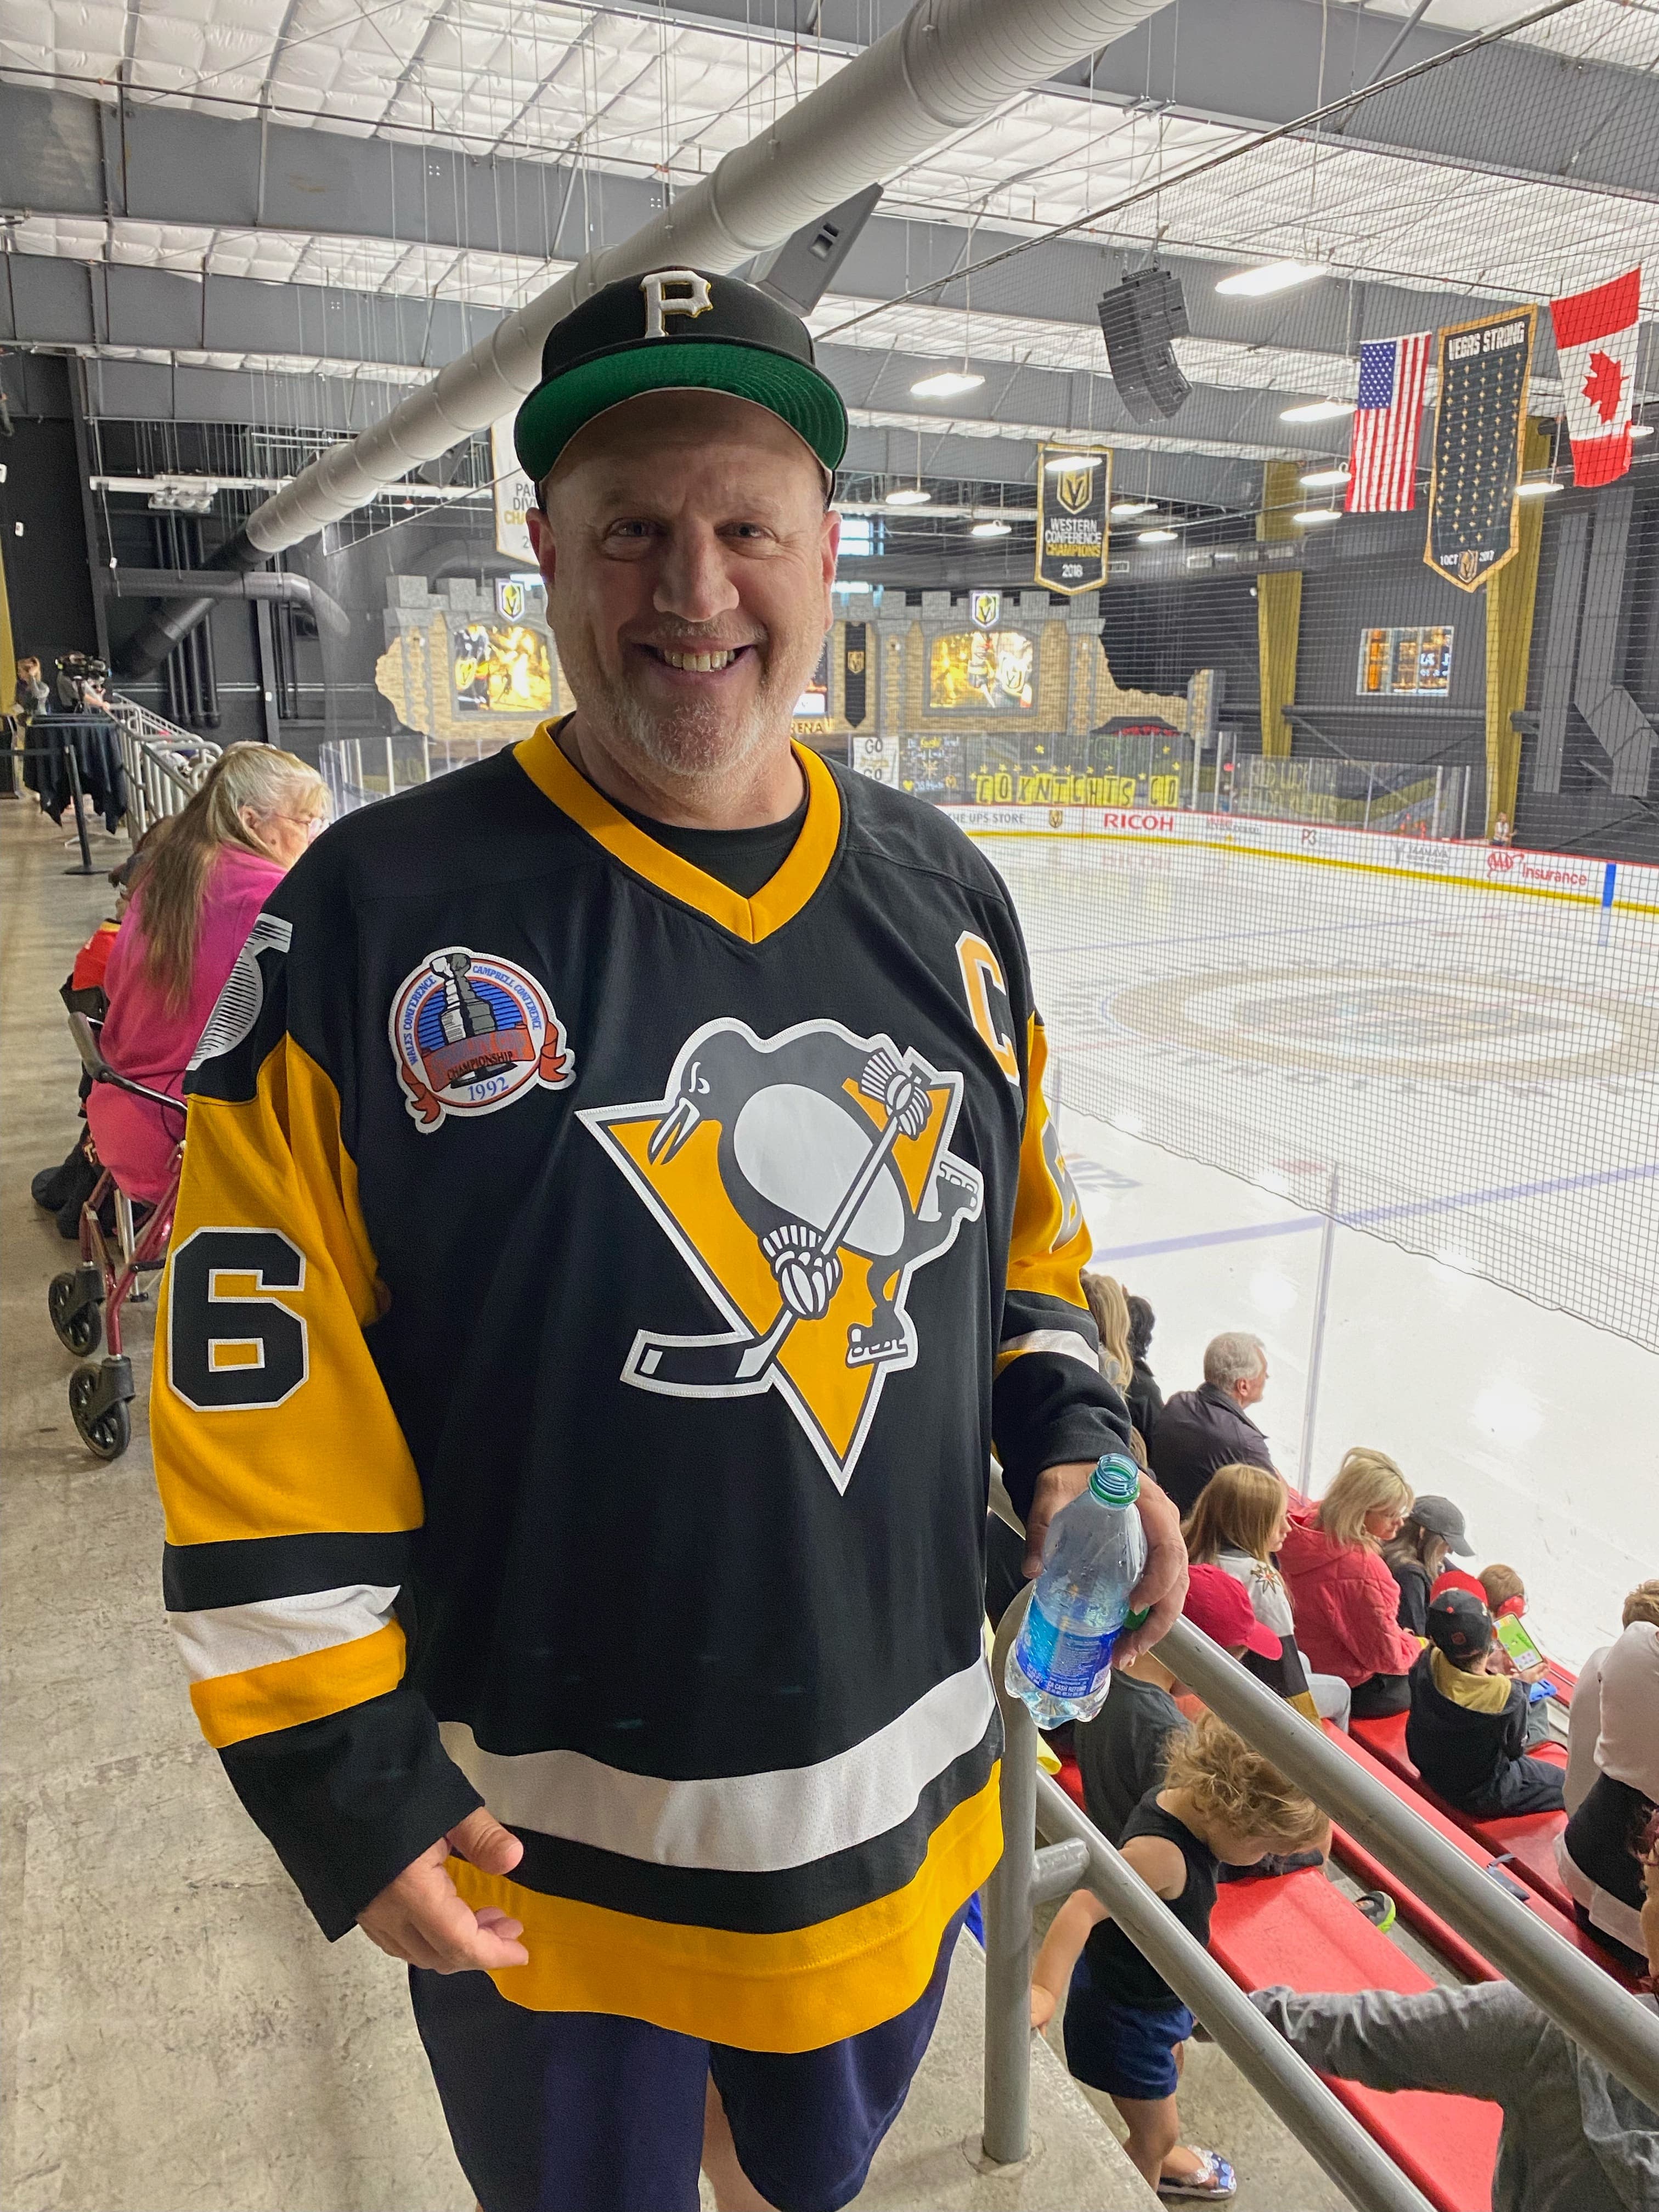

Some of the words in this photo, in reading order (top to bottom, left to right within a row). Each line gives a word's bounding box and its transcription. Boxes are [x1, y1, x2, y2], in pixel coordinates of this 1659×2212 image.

[639, 270, 713, 338] P
[1448, 332, 1481, 361] VEGAS
[1482, 321, 1525, 352] STRONG
[1050, 517, 1097, 532] WESTERN
[1045, 529, 1102, 545] CONFERENCE
[1046, 543, 1101, 558] CHAMPIONS
[1062, 564, 1084, 578] 2018
[790, 721, 823, 734] RENA
[865, 737, 883, 754] GO
[1019, 775, 1133, 805] KNIGHTS
[969, 813, 988, 823] UPS
[992, 813, 1026, 823] STORE
[1104, 813, 1173, 832] RICOH
[1522, 863, 1587, 885] Insurance
[472, 965, 515, 987] CAMPBELL
[514, 984, 542, 1030] CONFERENCE
[955, 930, 1020, 1087] C
[447, 1051, 514, 1080] CHAMPIONSHIP
[467, 1076, 509, 1101] 1992
[167, 1226, 309, 1412] 6
